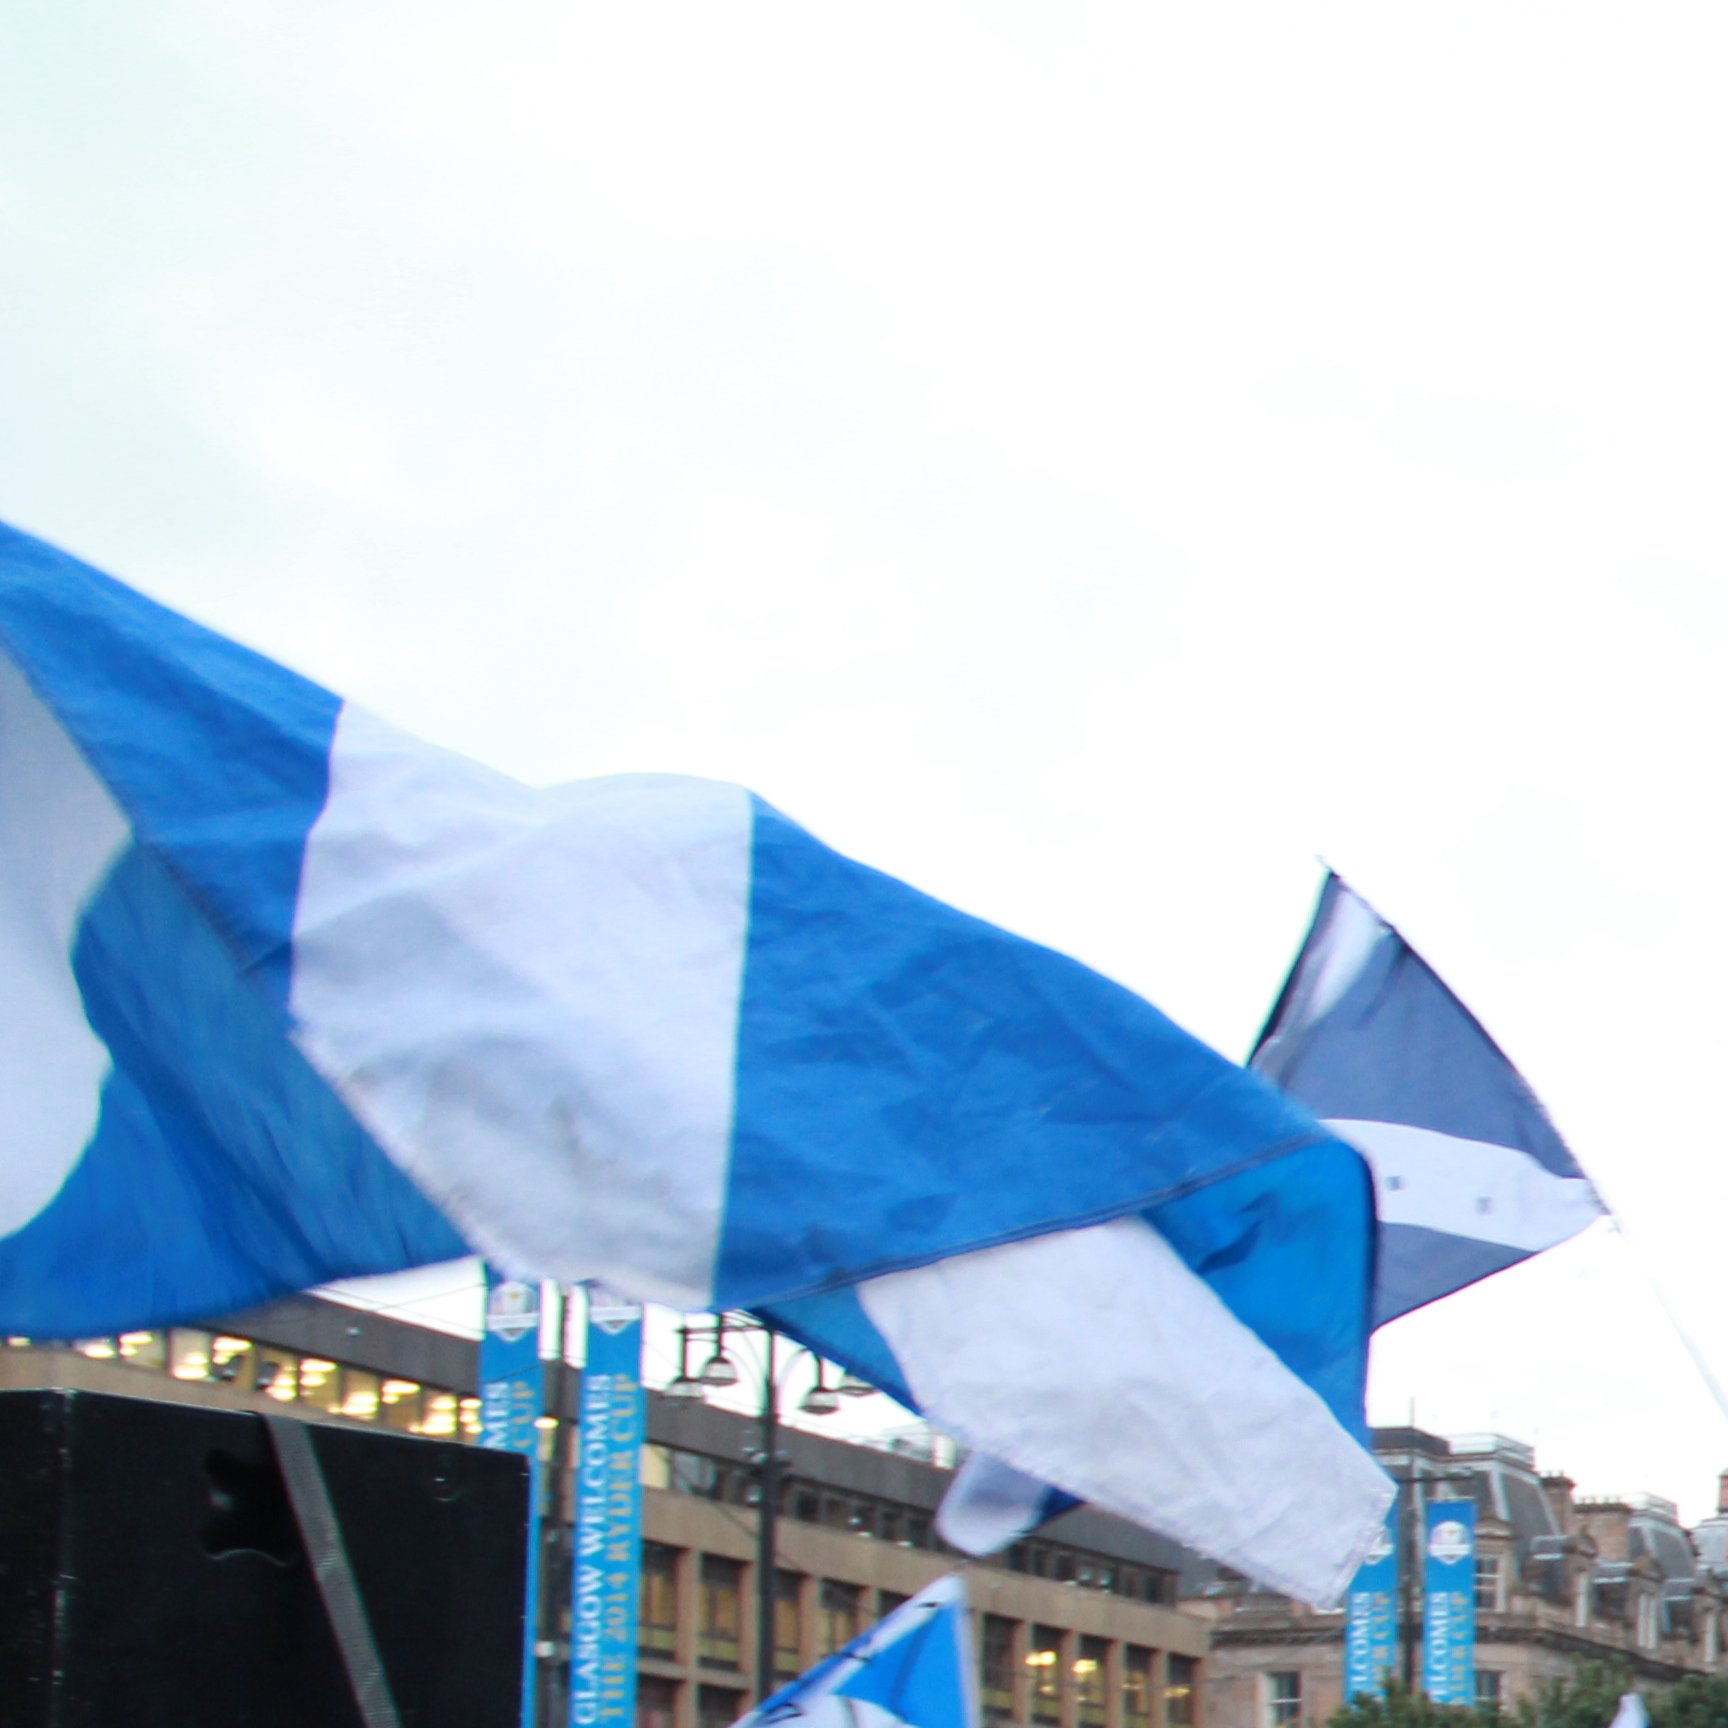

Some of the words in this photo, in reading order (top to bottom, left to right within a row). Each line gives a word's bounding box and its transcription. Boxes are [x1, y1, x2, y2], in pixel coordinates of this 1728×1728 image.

[611, 1374, 637, 1443] CUP
[580, 1374, 610, 1556] WELCOMES
[605, 1451, 635, 1561] RYDER
[573, 1565, 605, 1725] GLASGOW
[604, 1572, 630, 1642] 2014
[600, 1654, 627, 1722] THE
